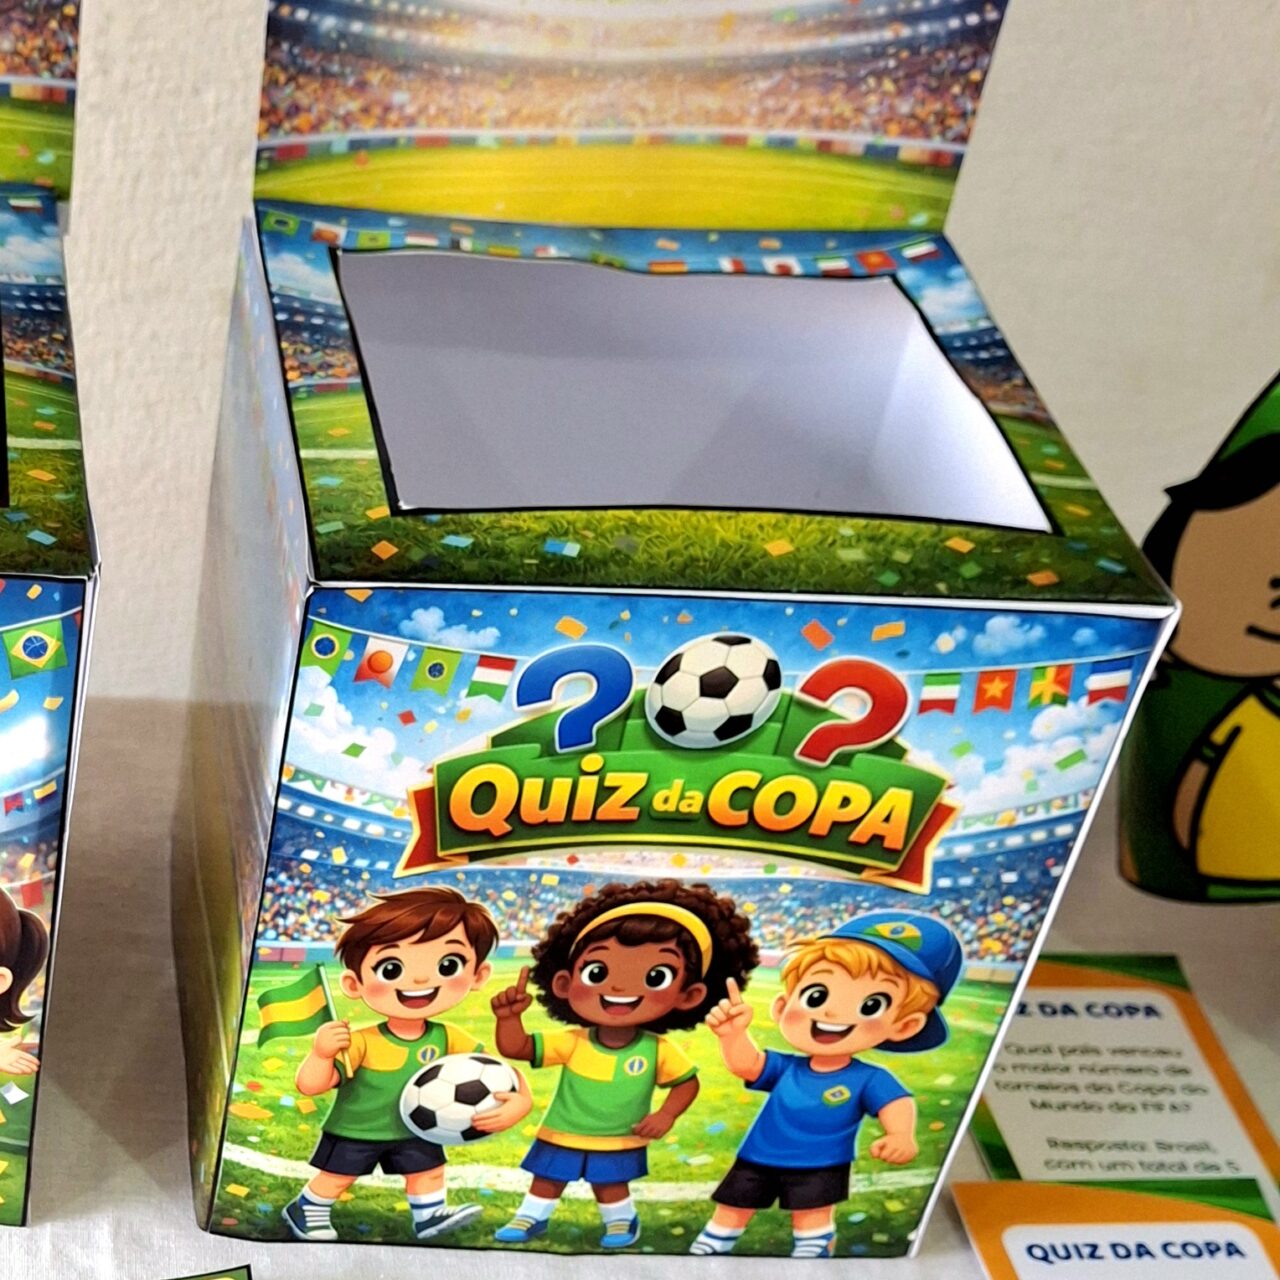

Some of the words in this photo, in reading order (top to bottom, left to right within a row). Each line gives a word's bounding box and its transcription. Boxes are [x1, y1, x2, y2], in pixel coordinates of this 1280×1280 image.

[449, 754, 648, 834] Quiz
[652, 779, 704, 814] da
[706, 769, 914, 852] COPA
[1038, 1002, 1078, 1017] DA
[1085, 1002, 1162, 1019] COPA
[1026, 1243, 1104, 1265] QUIZ
[1110, 1243, 1156, 1260] DA
[1161, 1241, 1246, 1260] COPA
